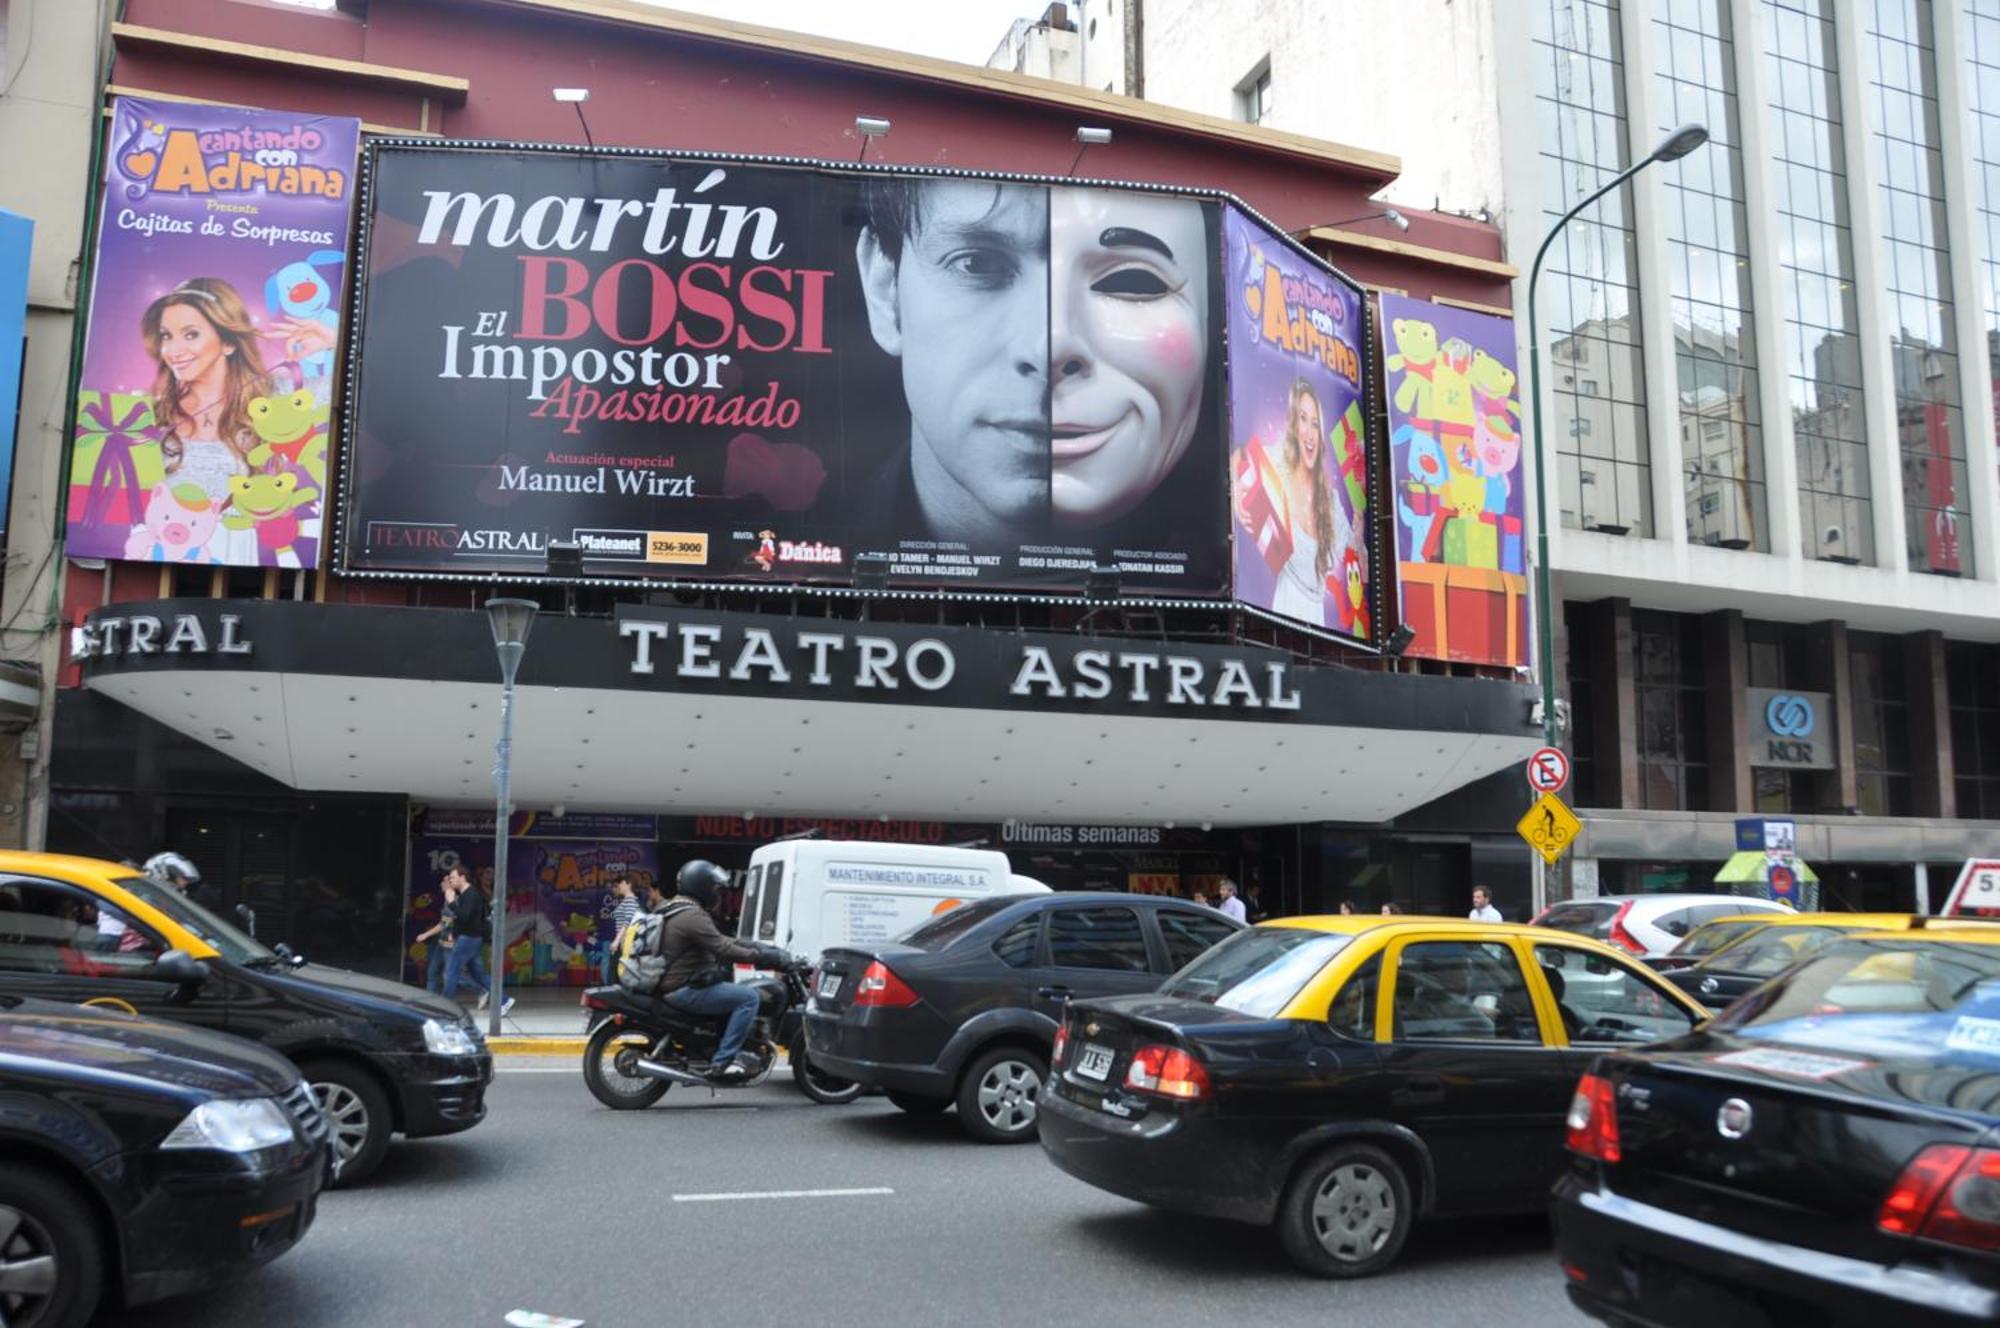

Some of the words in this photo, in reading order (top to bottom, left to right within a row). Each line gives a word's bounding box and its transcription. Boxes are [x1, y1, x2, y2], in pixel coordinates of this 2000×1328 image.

[199, 125, 322, 154] cantando
[152, 129, 345, 199] Adriana
[255, 148, 299, 167] con
[117, 208, 194, 237] Cajitas
[200, 215, 226, 237] de
[230, 219, 334, 246] Sorpresas
[417, 169, 785, 261] martín
[513, 254, 835, 355] BOSSI
[471, 311, 508, 338] El
[1262, 265, 1360, 385] Adriana
[1311, 308, 1335, 338] con
[438, 325, 731, 401] Impostor
[530, 382, 801, 435] Apasionado
[545, 450, 617, 468] Actuación
[618, 453, 676, 469] especial
[498, 463, 607, 495] Manuel
[612, 469, 696, 498] Wirzt
[373, 526, 460, 549] TEATRO
[456, 529, 545, 551] ASTRAL
[580, 535, 642, 551] Plateanet
[652, 541, 702, 553] 5236-3000
[936, 554, 972, 565] MANUEL
[1018, 557, 1046, 568] DIEGO
[72, 613, 253, 658] STRAL
[618, 618, 957, 691] TEATRO
[1009, 645, 1302, 710] ASTRAL
[1767, 738, 1814, 764] NCR
[1540, 756, 1556, 784] E
[1079, 826, 1161, 845] semanas
[828, 868, 914, 885] MANTENIMIENTO
[915, 872, 965, 886] INTEGRAL
